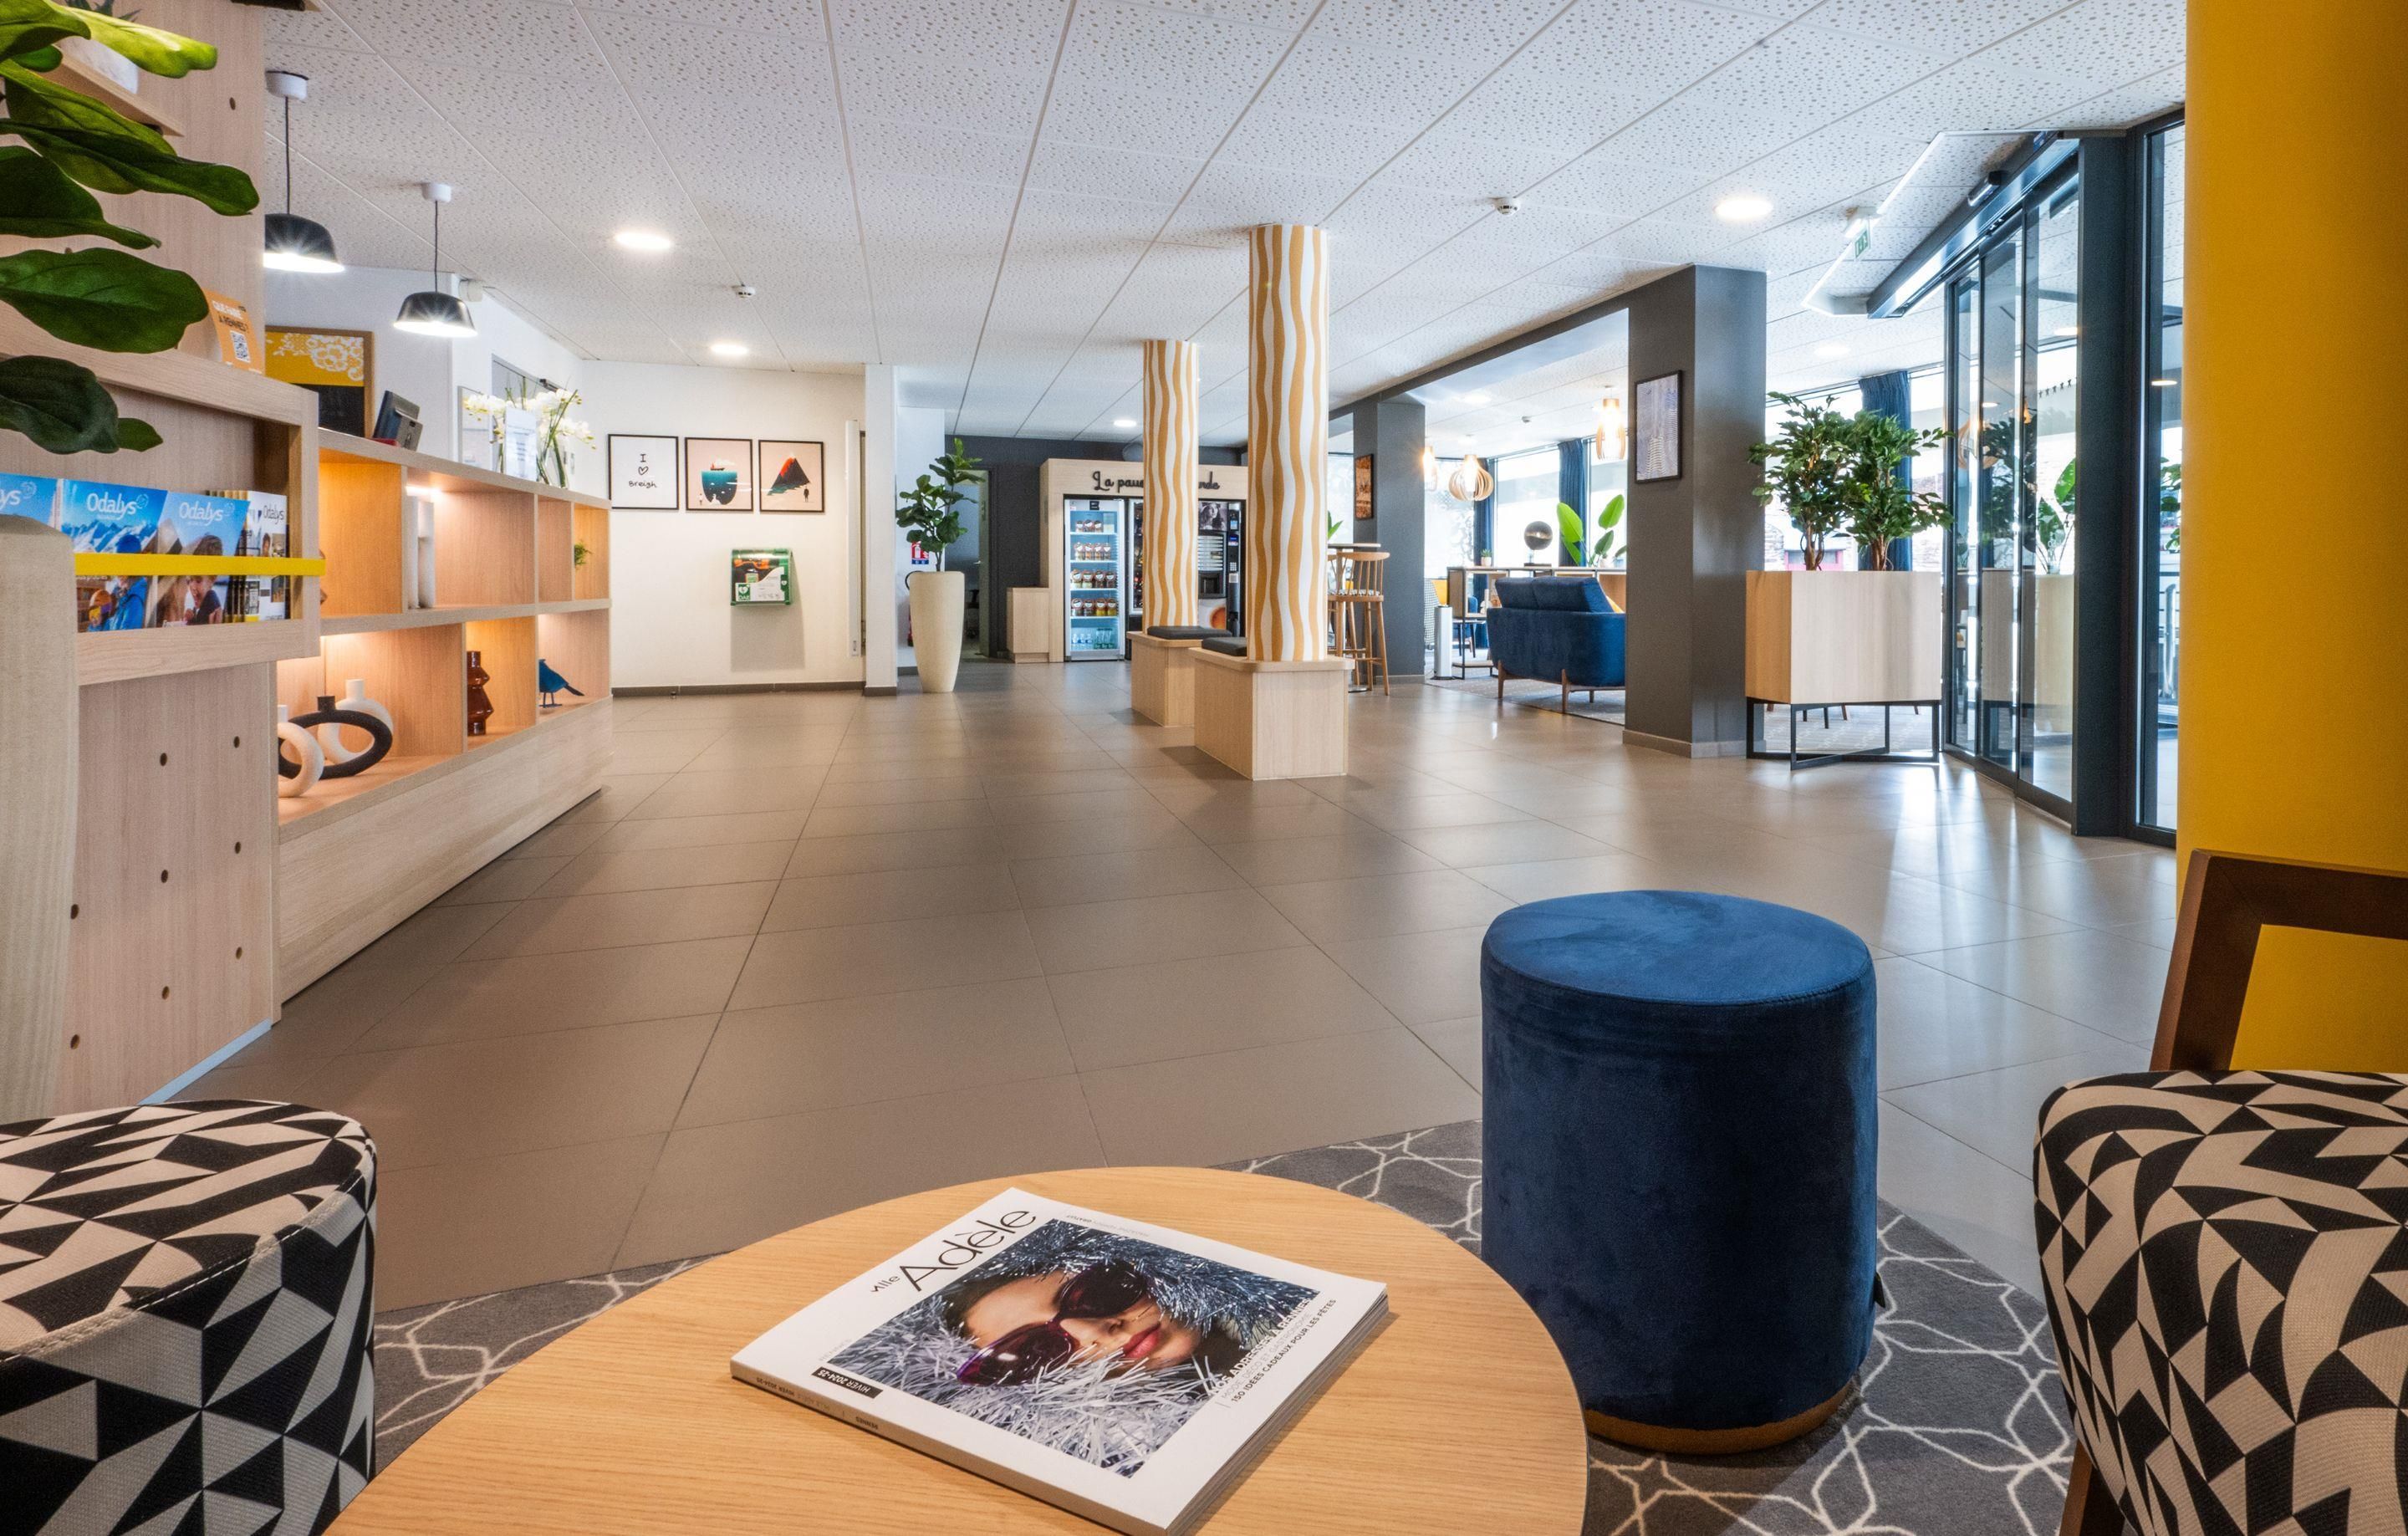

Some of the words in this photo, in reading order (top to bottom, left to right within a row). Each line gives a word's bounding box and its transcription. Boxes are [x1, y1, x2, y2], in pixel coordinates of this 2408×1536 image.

[640, 453, 646, 462] I
[1092, 471, 1115, 492] La
[1117, 479, 1144, 493] pau
[86, 492, 137, 520] Odalys
[179, 501, 224, 526] Odalys
[263, 504, 284, 524] Odalys
[899, 1210, 1037, 1293] Adèle
[1229, 1335, 1273, 1379] ADRESSES
[1277, 1298, 1311, 1329] RENNES
[1231, 1390, 1246, 1403] 150
[1262, 1344, 1293, 1372] CADEAUX
[1290, 1327, 1309, 1345] POUR
[1307, 1316, 1320, 1329] LES
[845, 1380, 871, 1394] HIVER
